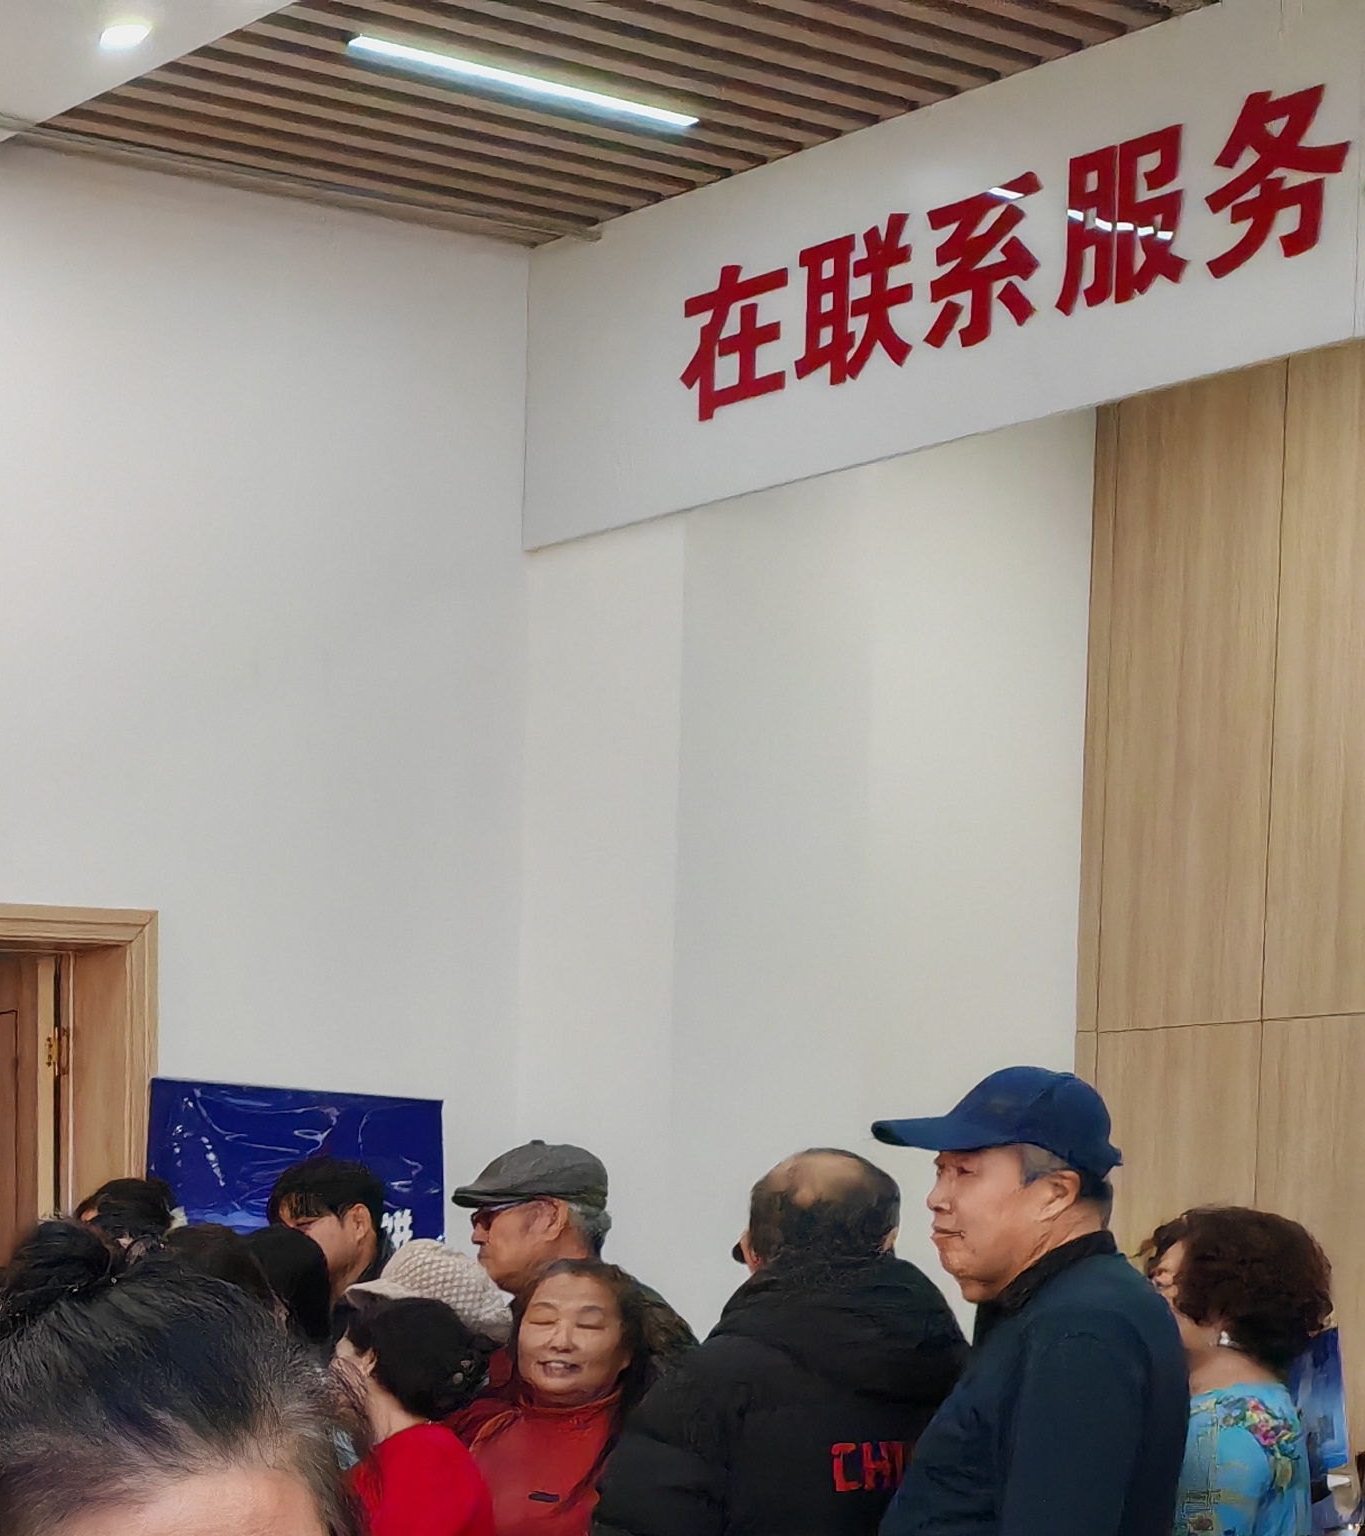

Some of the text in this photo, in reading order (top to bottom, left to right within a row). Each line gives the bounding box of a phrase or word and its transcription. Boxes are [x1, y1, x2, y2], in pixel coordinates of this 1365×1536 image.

[679, 84, 1352, 423] 在联系服务
